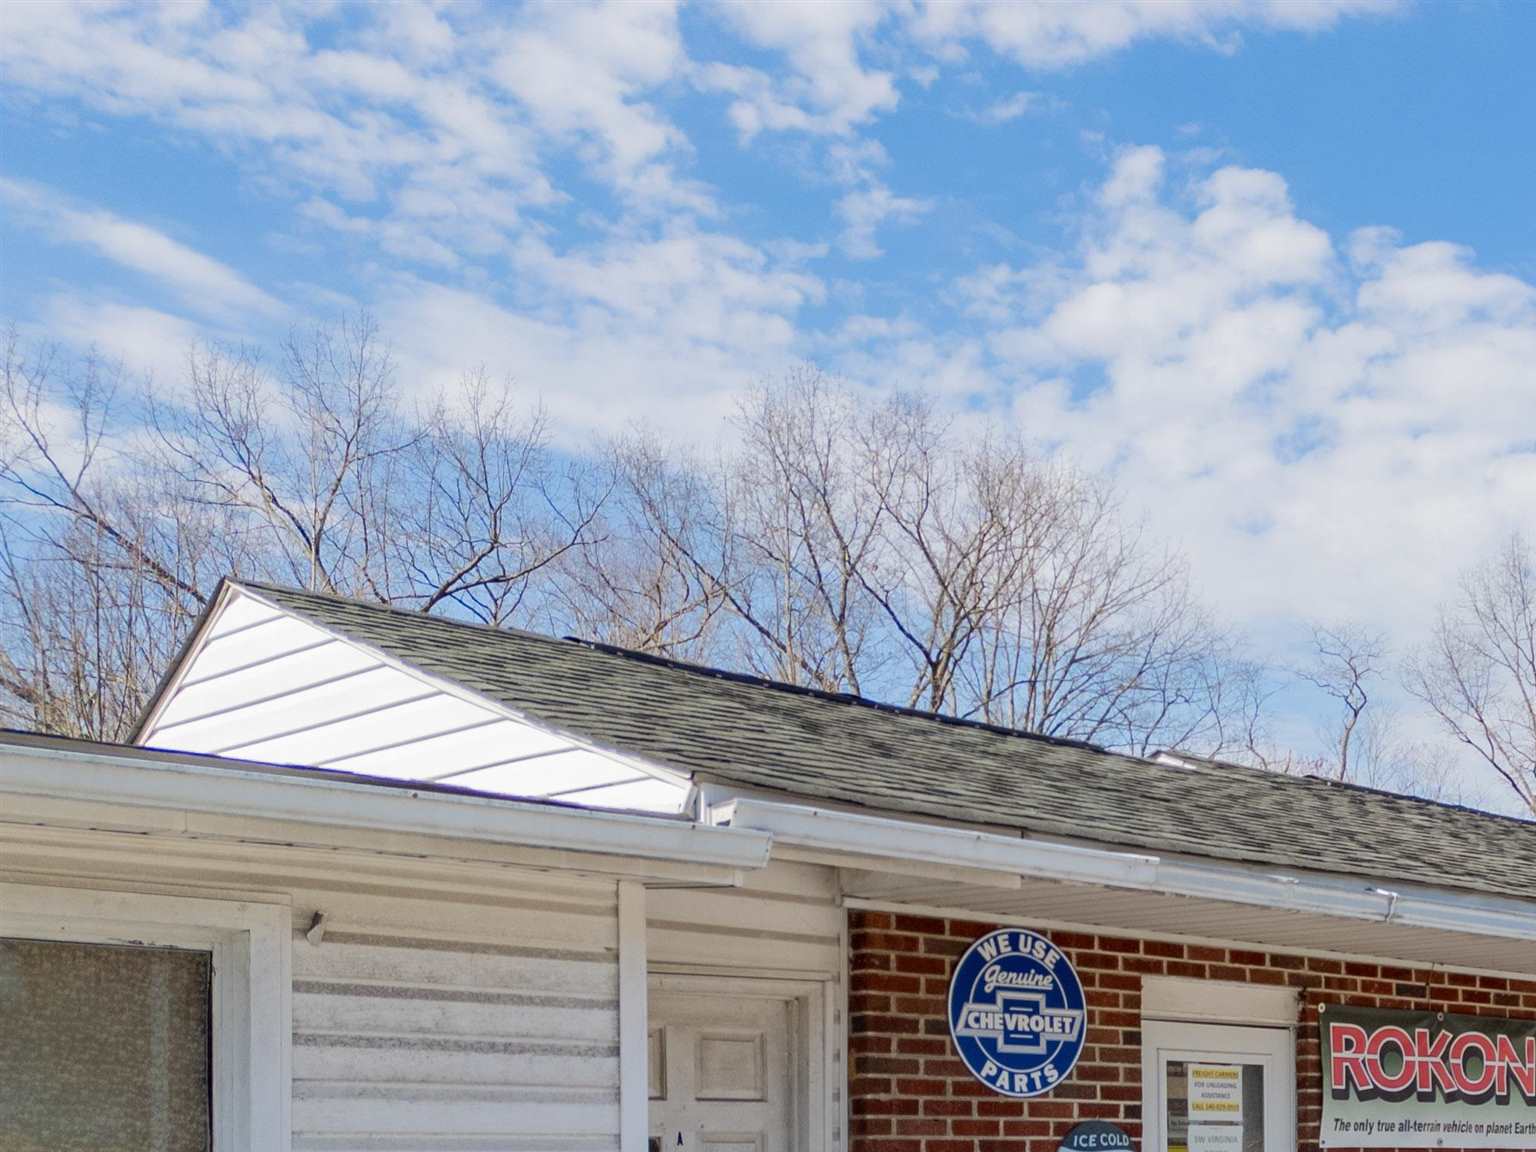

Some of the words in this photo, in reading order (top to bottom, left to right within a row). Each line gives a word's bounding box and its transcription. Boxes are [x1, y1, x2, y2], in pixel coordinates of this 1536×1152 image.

[977, 934, 1012, 962] WE
[1018, 934, 1061, 970] USE
[984, 965, 1053, 994] Genuine
[967, 1011, 1073, 1034] CHEVROLET
[1330, 1022, 1536, 1098] ROKON
[981, 1060, 1059, 1093] PARTS
[1074, 1134, 1097, 1147] ICE
[1100, 1133, 1130, 1147] COLD
[1333, 1118, 1350, 1132] The
[1353, 1119, 1374, 1136] only
[1377, 1120, 1395, 1132] true
[1398, 1119, 1441, 1133] all-terrain
[1443, 1121, 1473, 1134] vehicle
[1474, 1124, 1484, 1134] on
[1485, 1123, 1512, 1137] planet
[1514, 1122, 1536, 1135] Earth
